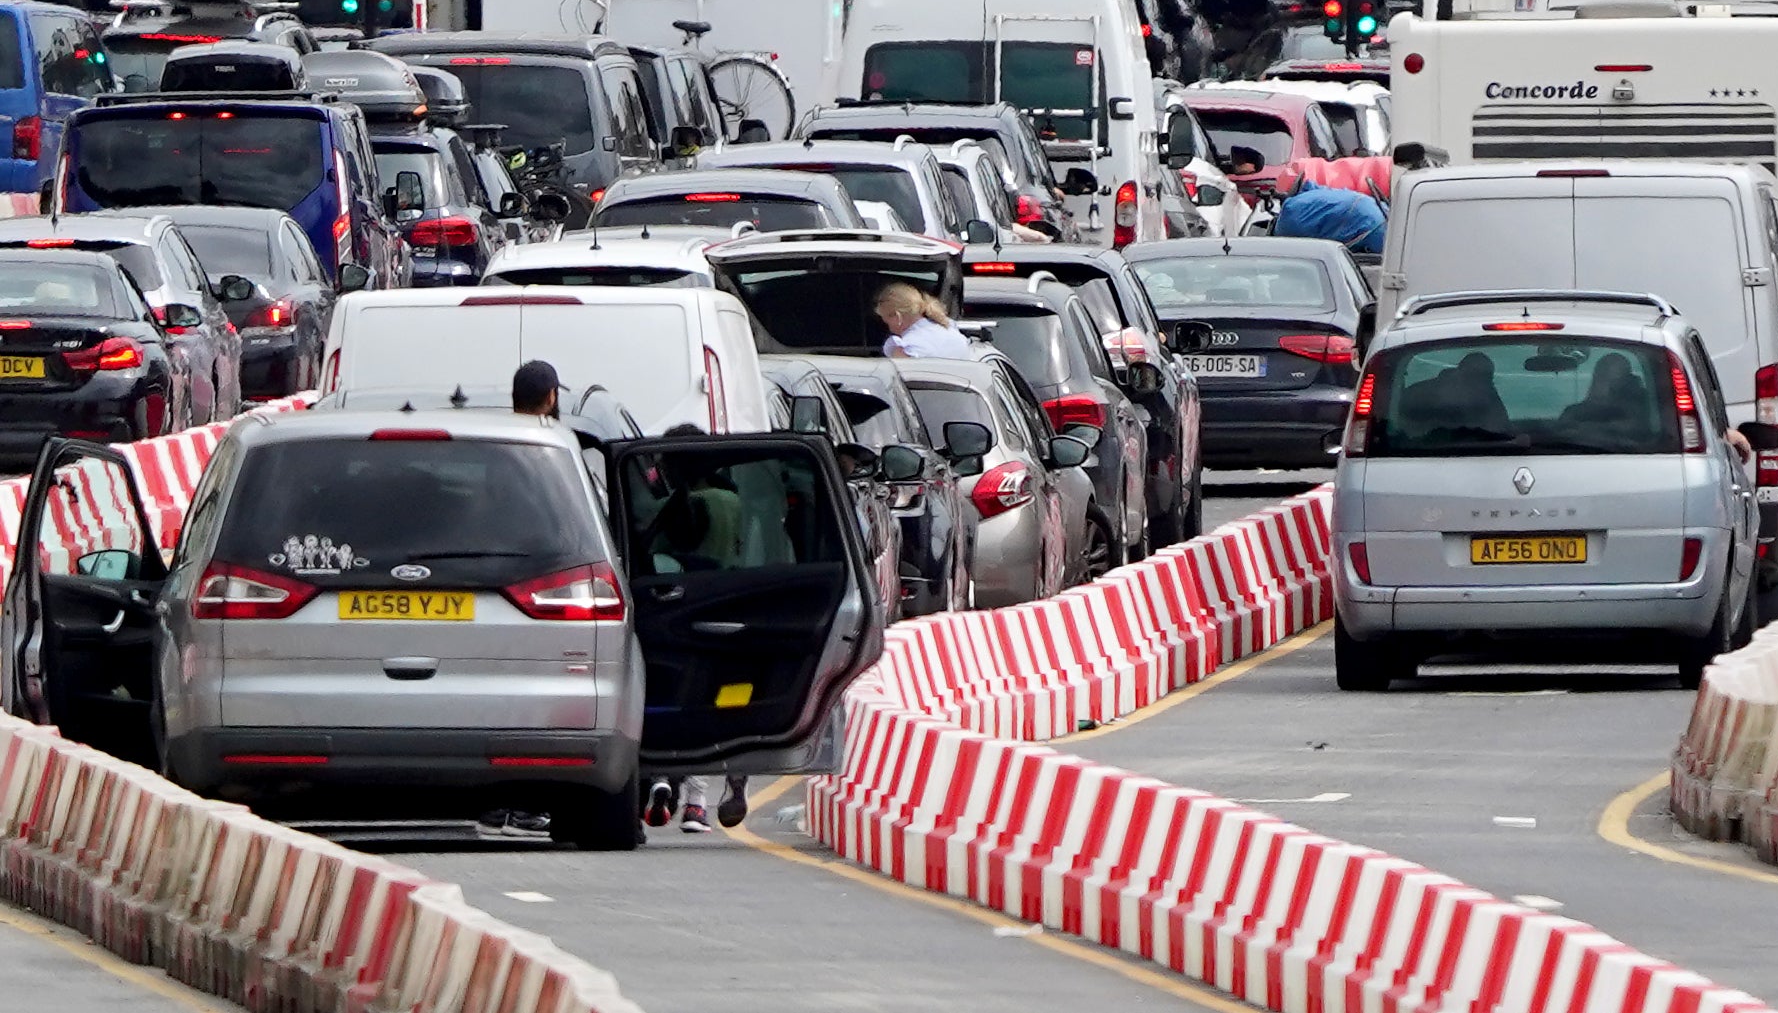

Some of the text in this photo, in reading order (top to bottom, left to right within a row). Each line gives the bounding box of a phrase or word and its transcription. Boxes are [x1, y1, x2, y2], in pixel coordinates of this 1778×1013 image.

[1485, 81, 1599, 100] Concorde
[2, 358, 34, 374] DCV
[1480, 541, 1578, 560] AF56 ONO
[350, 593, 464, 615] AG58 YJY
